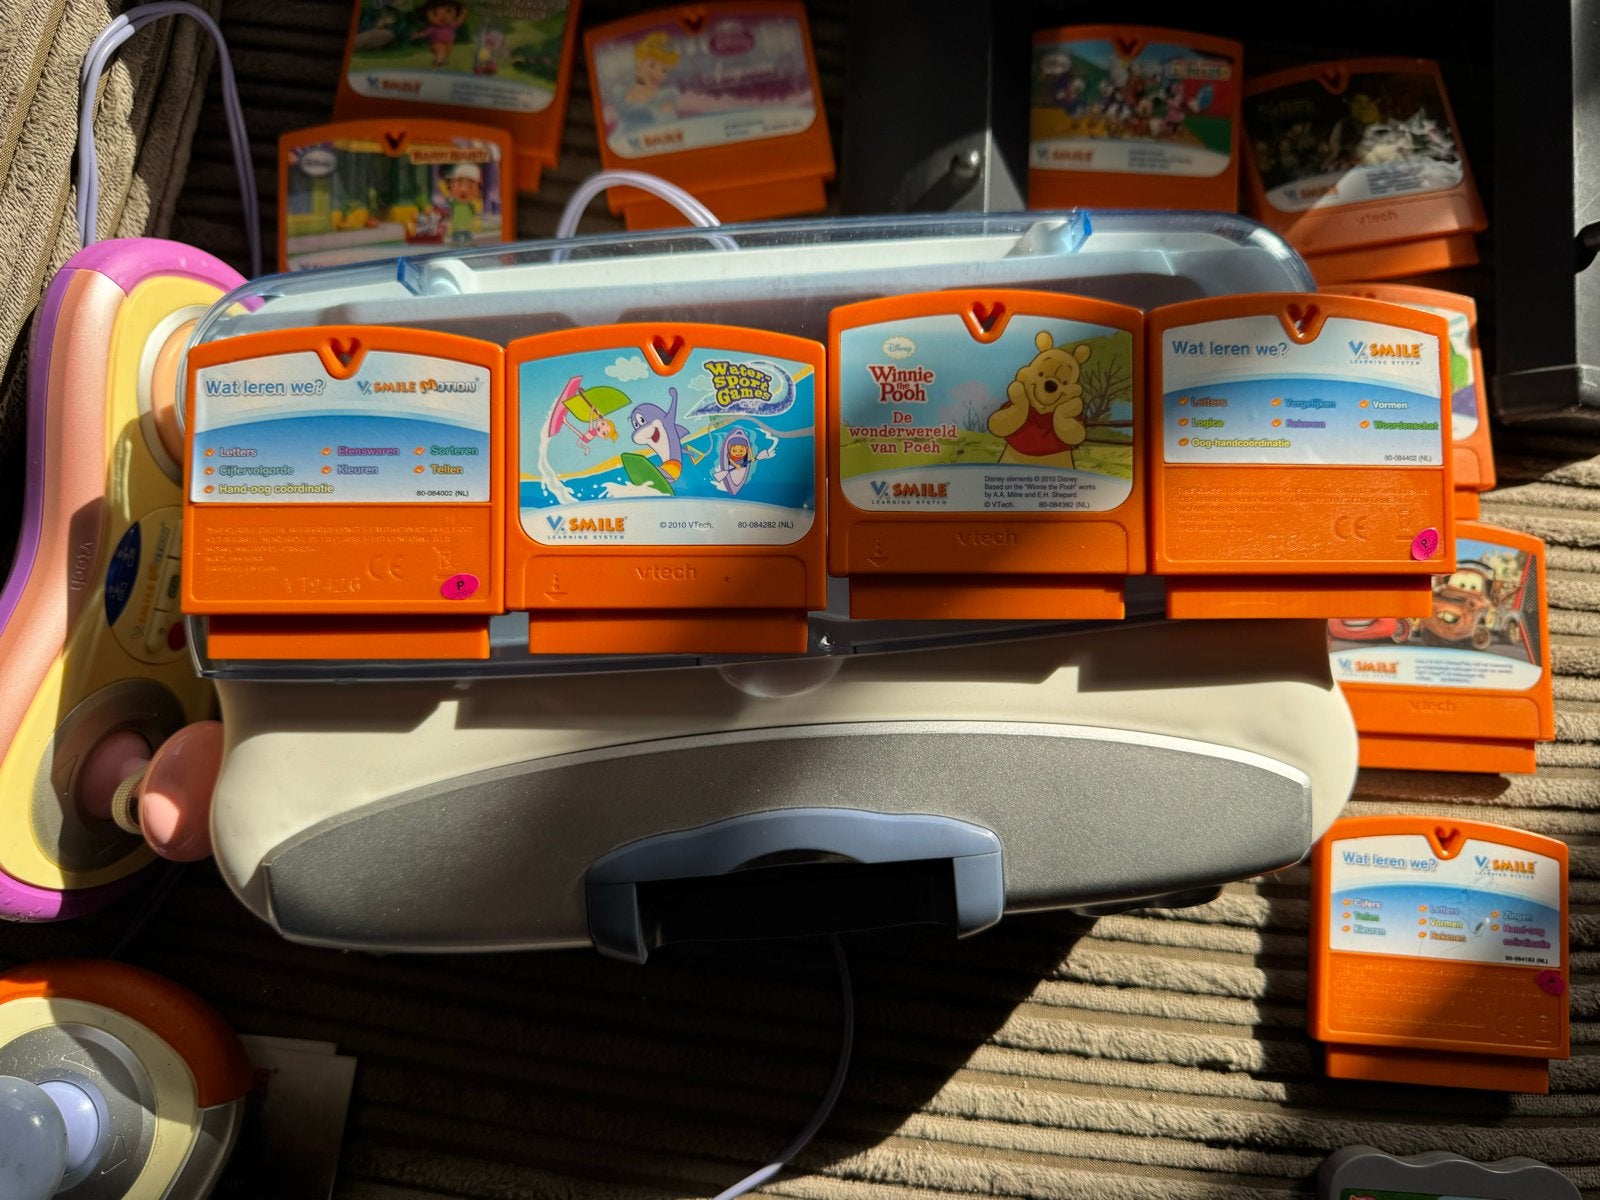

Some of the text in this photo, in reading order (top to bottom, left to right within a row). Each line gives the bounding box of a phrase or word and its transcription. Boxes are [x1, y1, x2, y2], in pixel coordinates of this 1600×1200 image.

[1355, 208, 1398, 226] vtech
[1172, 341, 1289, 357] Wat leren we?
[1369, 342, 1421, 358] SMILE
[704, 361, 772, 381] Water-
[868, 365, 934, 383] Winnie
[205, 379, 326, 396] Wat leren we?
[373, 381, 416, 393] SMILE
[880, 382, 926, 402] Pooh
[897, 382, 910, 390] the
[716, 388, 773, 407] Games
[1373, 400, 1408, 410] Vormen
[893, 412, 912, 424] De
[1191, 418, 1224, 429] Logica
[849, 425, 957, 438] wonderwereld
[871, 441, 941, 454] van Poeh
[1191, 437, 1290, 449] Oog-handcoördinatie
[219, 447, 257, 457] Letters
[337, 446, 401, 456] Etenswaren
[430, 445, 479, 456] Sorteren
[219, 465, 295, 477] Cijfervolgorde
[337, 464, 379, 475] Kleuren
[430, 464, 464, 475] Tellen
[984, 475, 1004, 483] Disney
[219, 483, 334, 496] Hand-oog coördinatie
[892, 482, 947, 497] SMILE
[569, 517, 625, 532] SMILE
[778, 521, 794, 529] (NL)
[956, 529, 1018, 547] vtech
[635, 564, 698, 581] vtech
[1409, 701, 1456, 714] vtech
[1343, 851, 1438, 872] Wat leren we?
[1492, 858, 1536, 874] SMILE
[1353, 924, 1387, 936] Kleuren
[1430, 918, 1463, 929] Vormen
